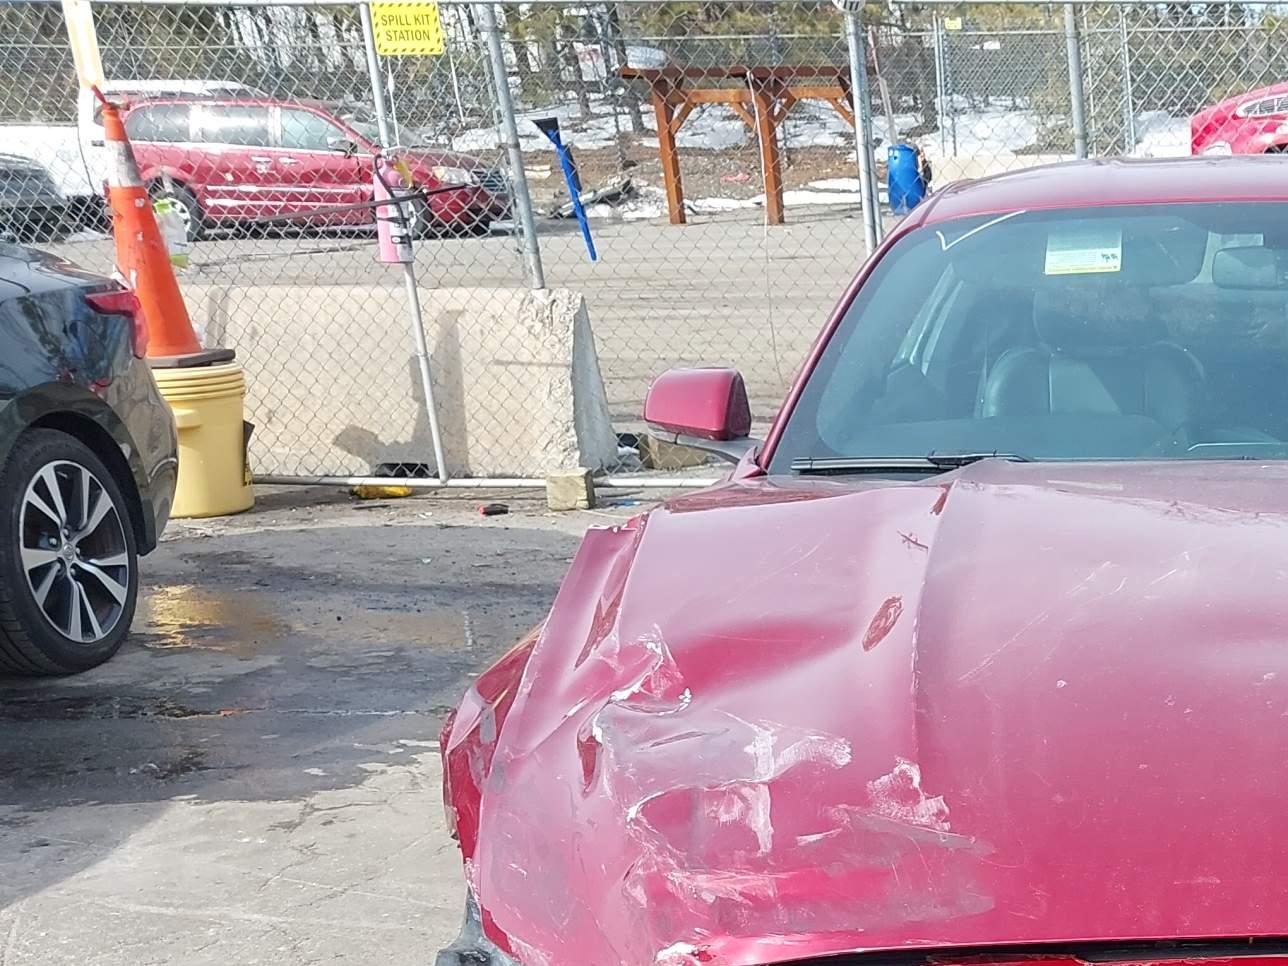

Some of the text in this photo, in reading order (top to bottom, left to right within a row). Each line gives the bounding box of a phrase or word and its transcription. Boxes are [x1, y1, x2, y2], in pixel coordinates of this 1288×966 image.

[380, 14, 431, 26] SPILL KIT
[386, 30, 431, 42] STATION
